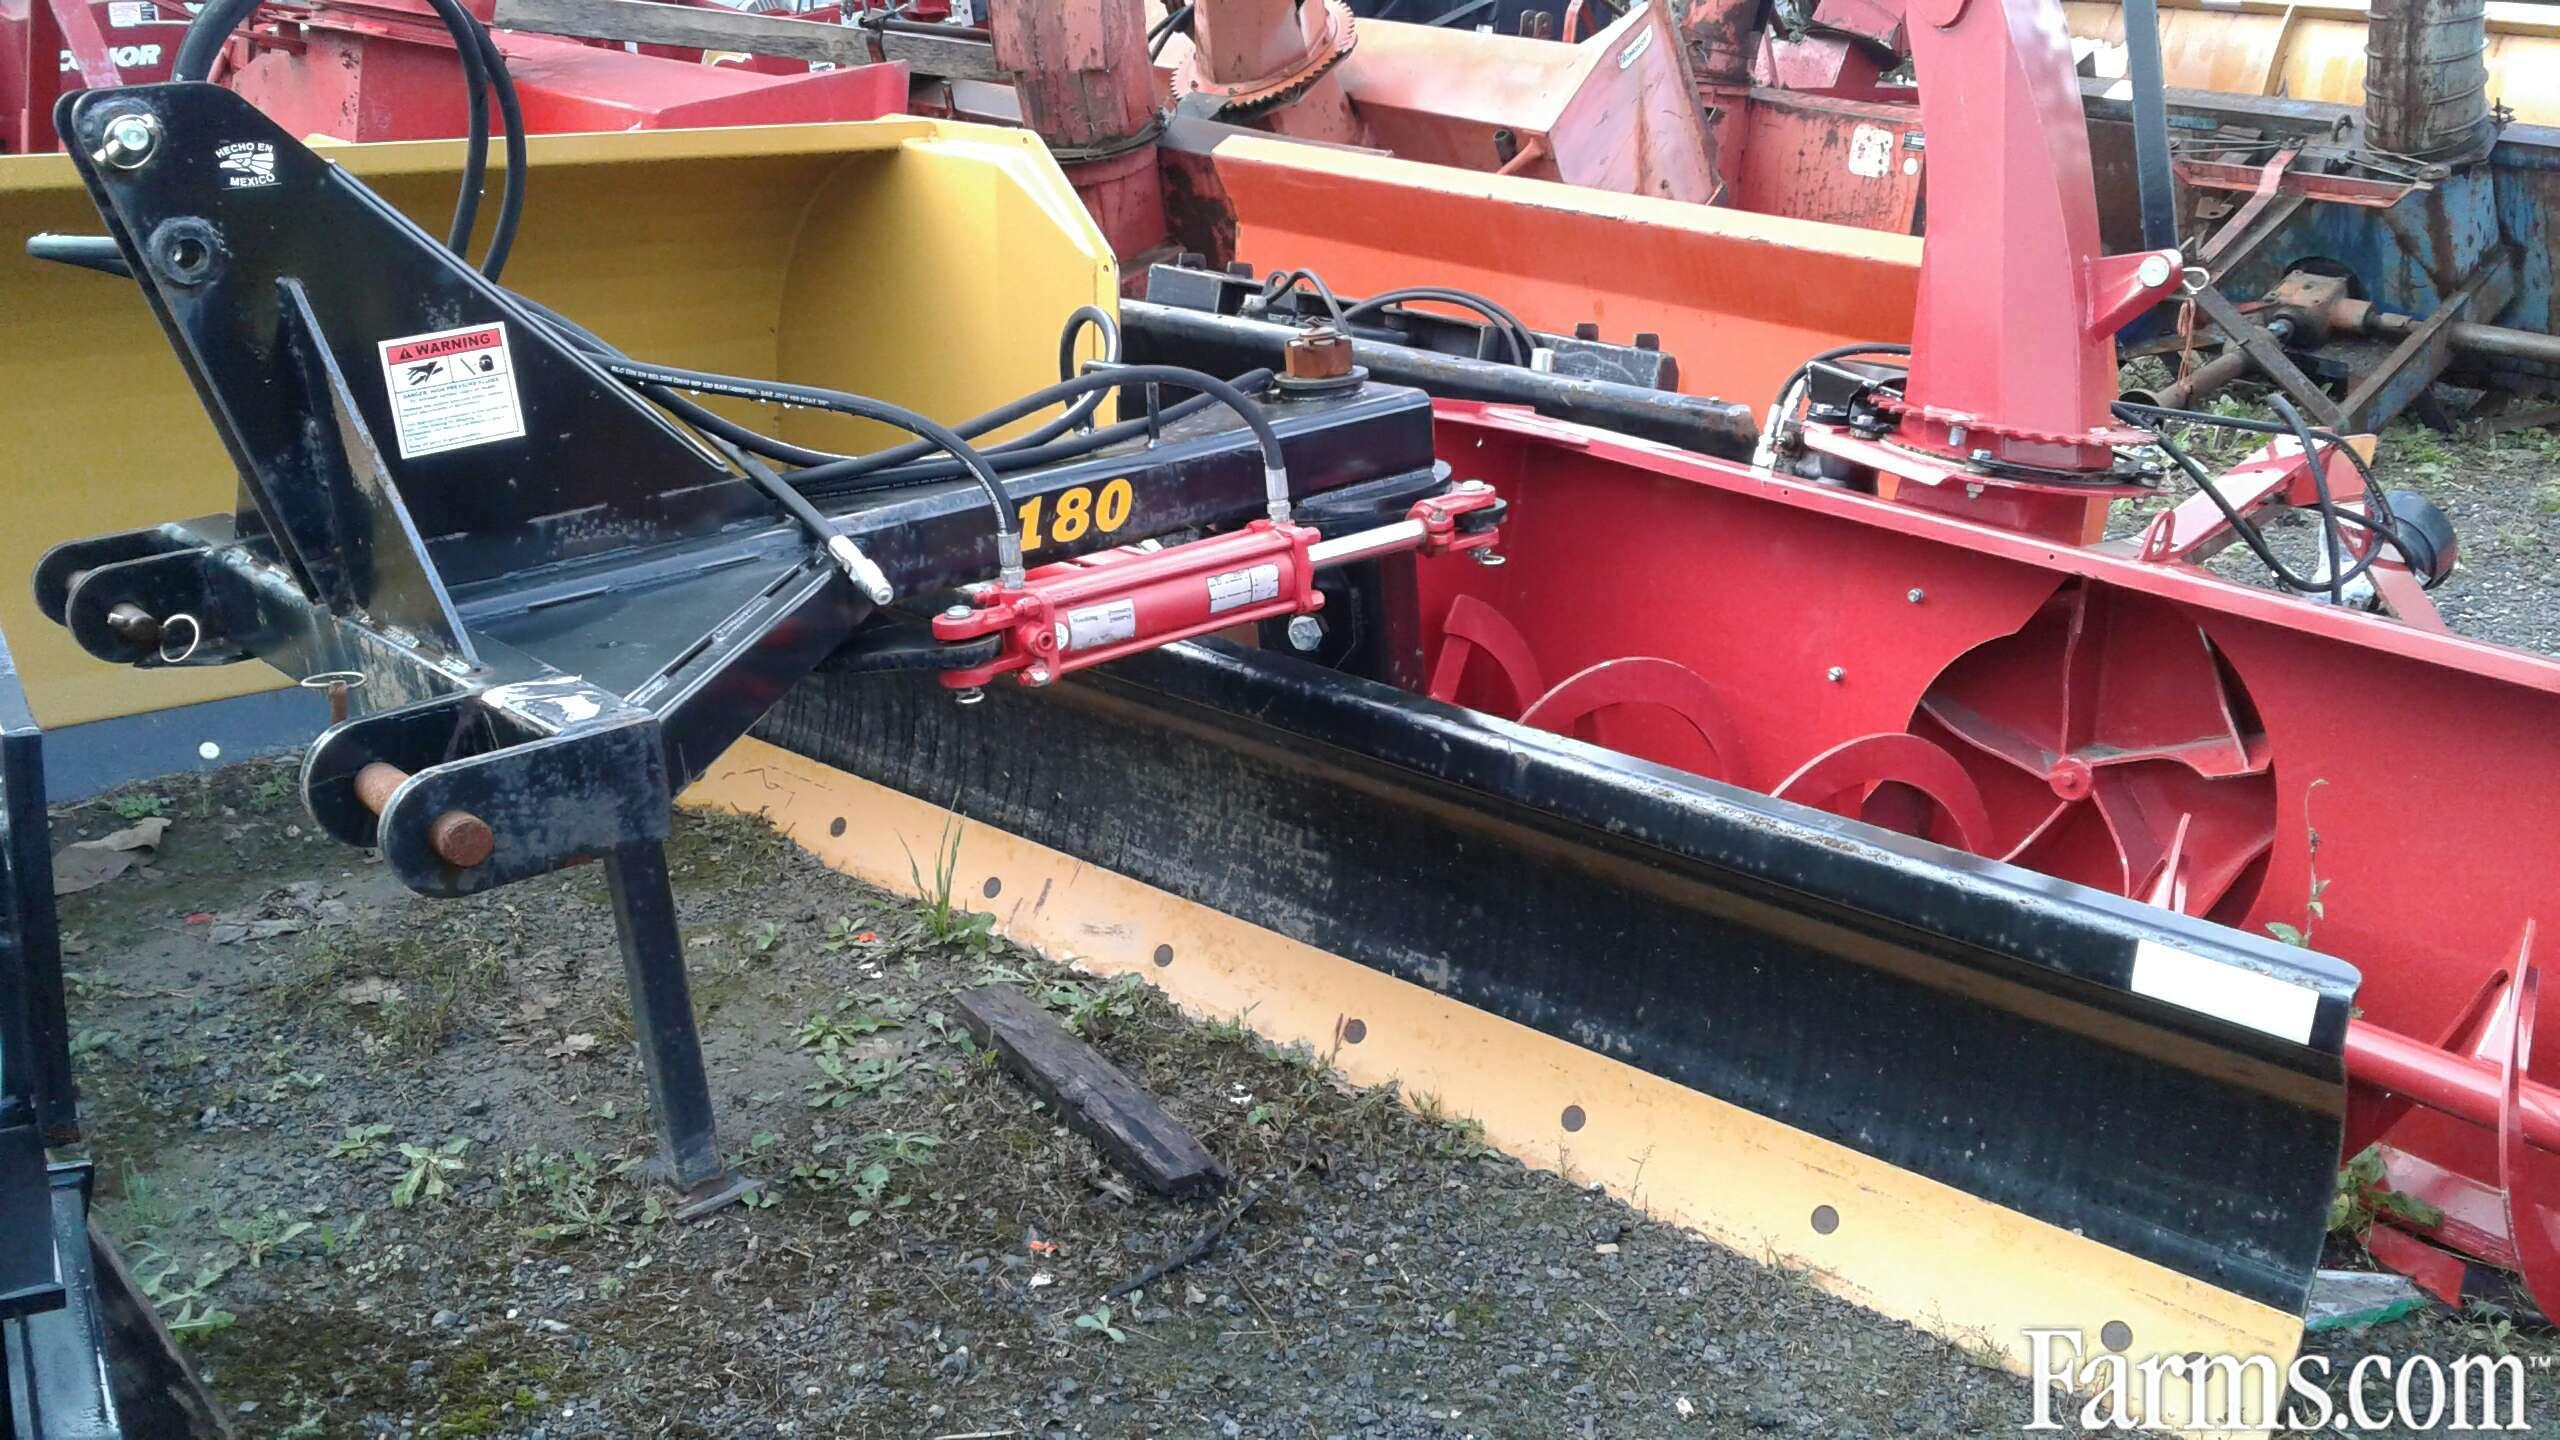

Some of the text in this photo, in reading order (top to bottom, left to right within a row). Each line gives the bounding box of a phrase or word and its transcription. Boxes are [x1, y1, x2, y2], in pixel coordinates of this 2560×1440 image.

[215, 142, 274, 158] HECHO EN
[229, 173, 276, 187] MEXICO
[415, 333, 491, 356] WARNING
[1019, 478, 1133, 552] 180
